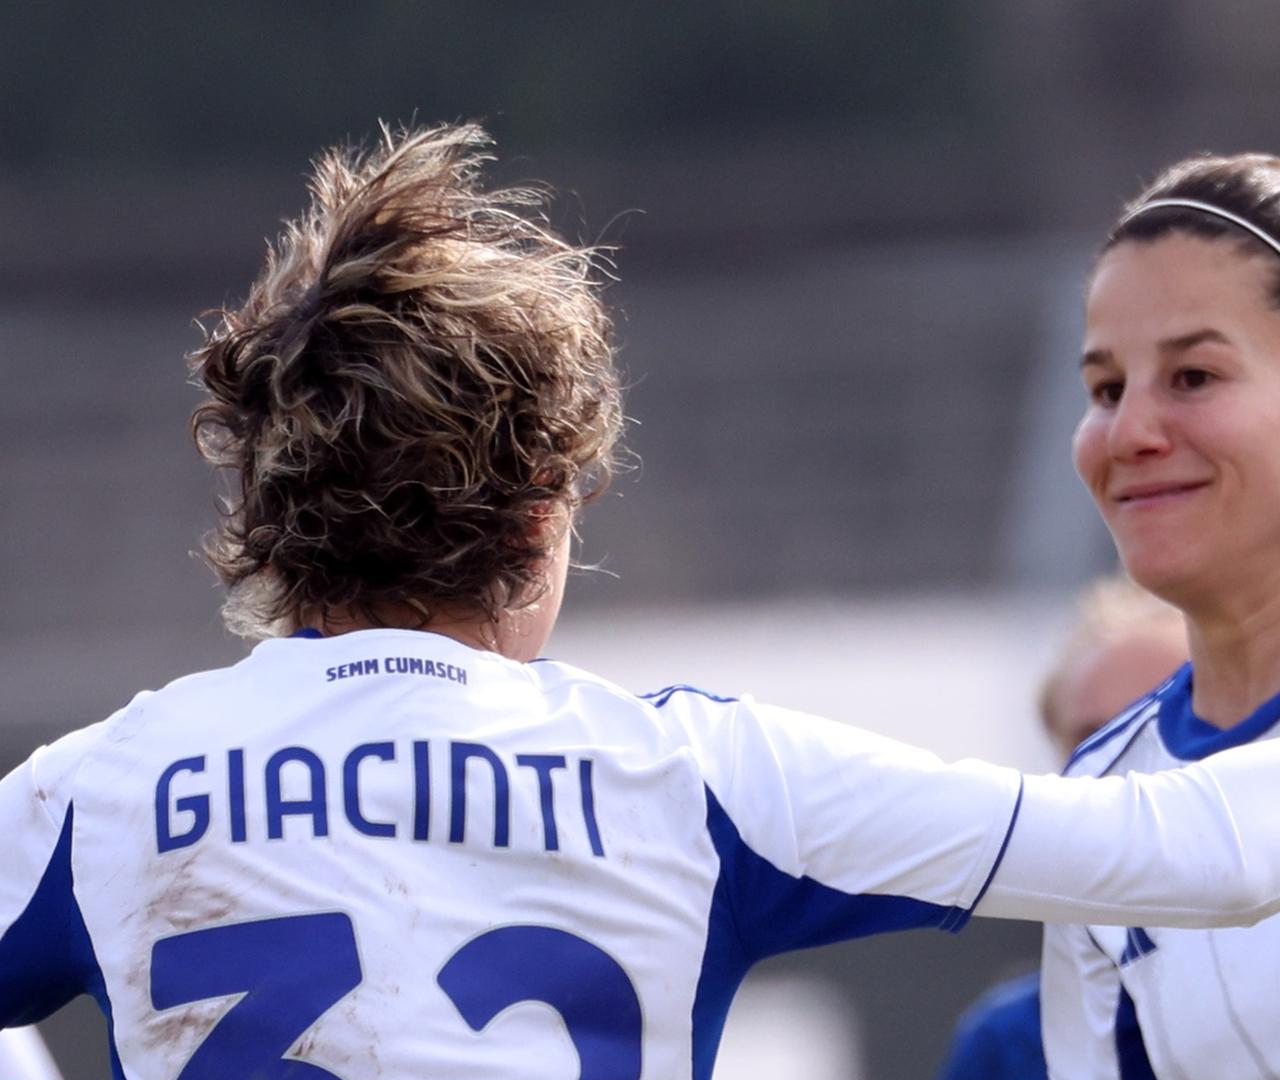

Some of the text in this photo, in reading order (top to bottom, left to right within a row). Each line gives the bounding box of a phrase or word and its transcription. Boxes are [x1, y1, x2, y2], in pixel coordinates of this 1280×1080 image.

[326, 657, 467, 686] SEMM CUMASCH
[155, 740, 606, 857] GIACINTI
